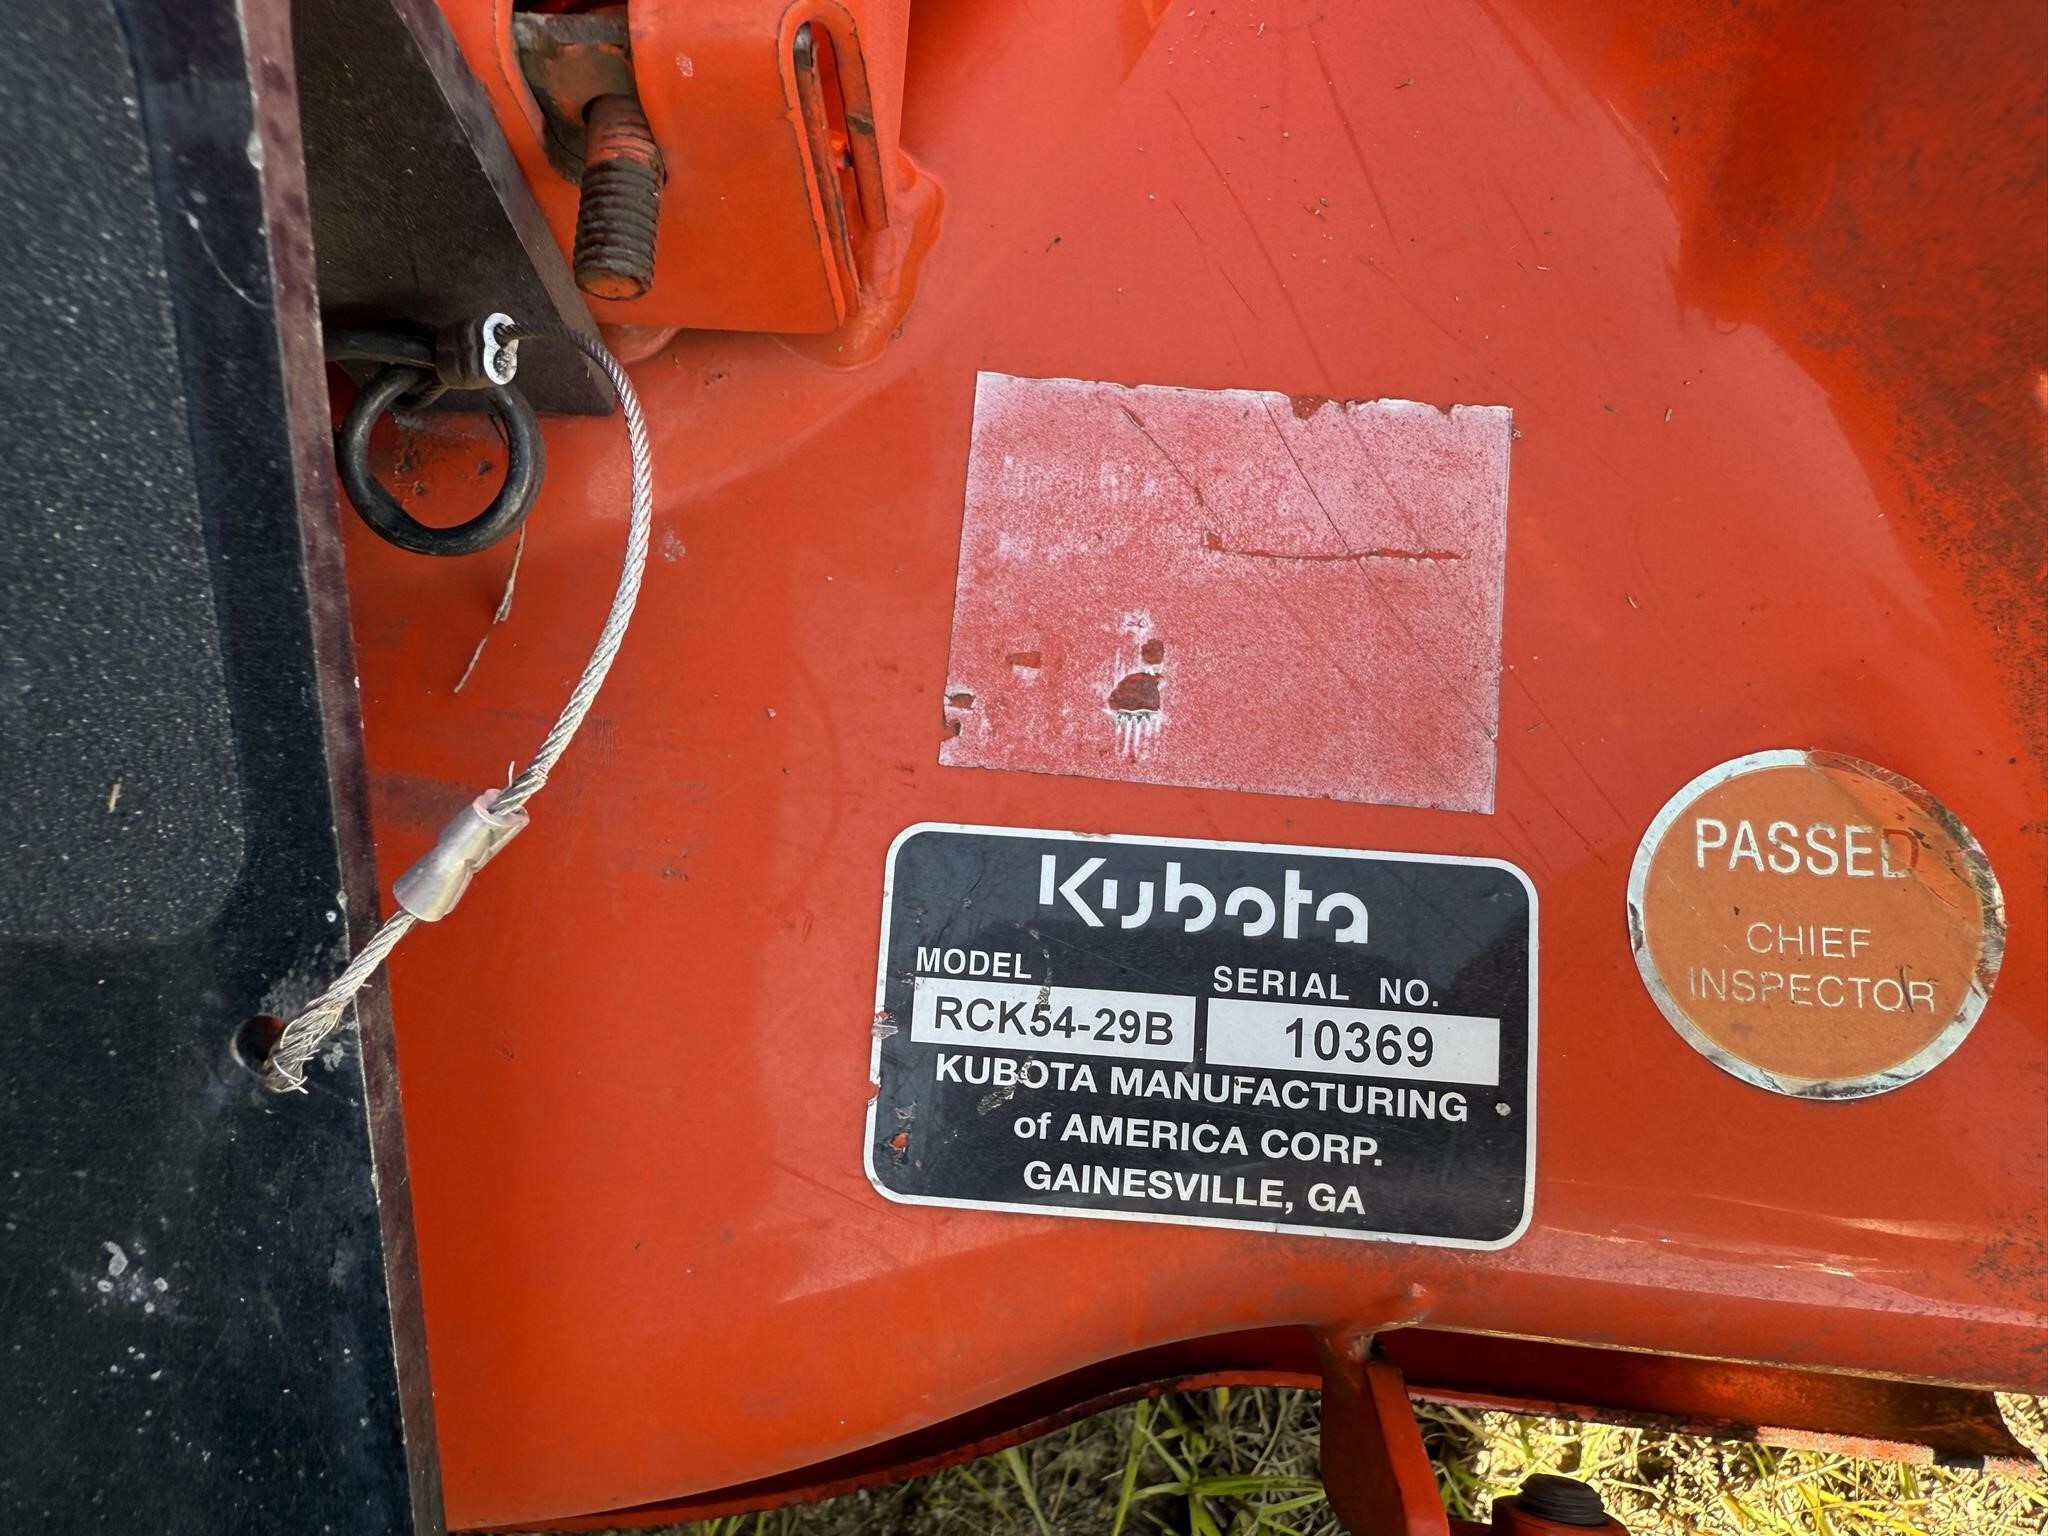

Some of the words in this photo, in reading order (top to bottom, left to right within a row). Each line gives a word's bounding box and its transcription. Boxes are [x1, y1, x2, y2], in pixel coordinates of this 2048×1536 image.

[1695, 817, 1918, 878] PASSED
[1039, 855, 1368, 944] Kubota
[916, 947, 1032, 979] MODEL
[1746, 923, 1871, 958] CHIEF
[1213, 966, 1349, 1001] SERIAL
[1379, 976, 1438, 1008] NO.
[1689, 967, 1935, 1013] INSPECTOR
[934, 996, 1174, 1046] RCK54-29B
[1285, 1017, 1433, 1067] 10369
[936, 1054, 1097, 1092] KUBOTA
[1110, 1067, 1468, 1122] MANUFACTURING
[1014, 1114, 1052, 1138] of
[1060, 1116, 1246, 1157] AMERICA
[1260, 1130, 1382, 1167] CORP.
[1023, 1162, 1293, 1214] GAINESVILLE,
[1308, 1182, 1365, 1215] GA
